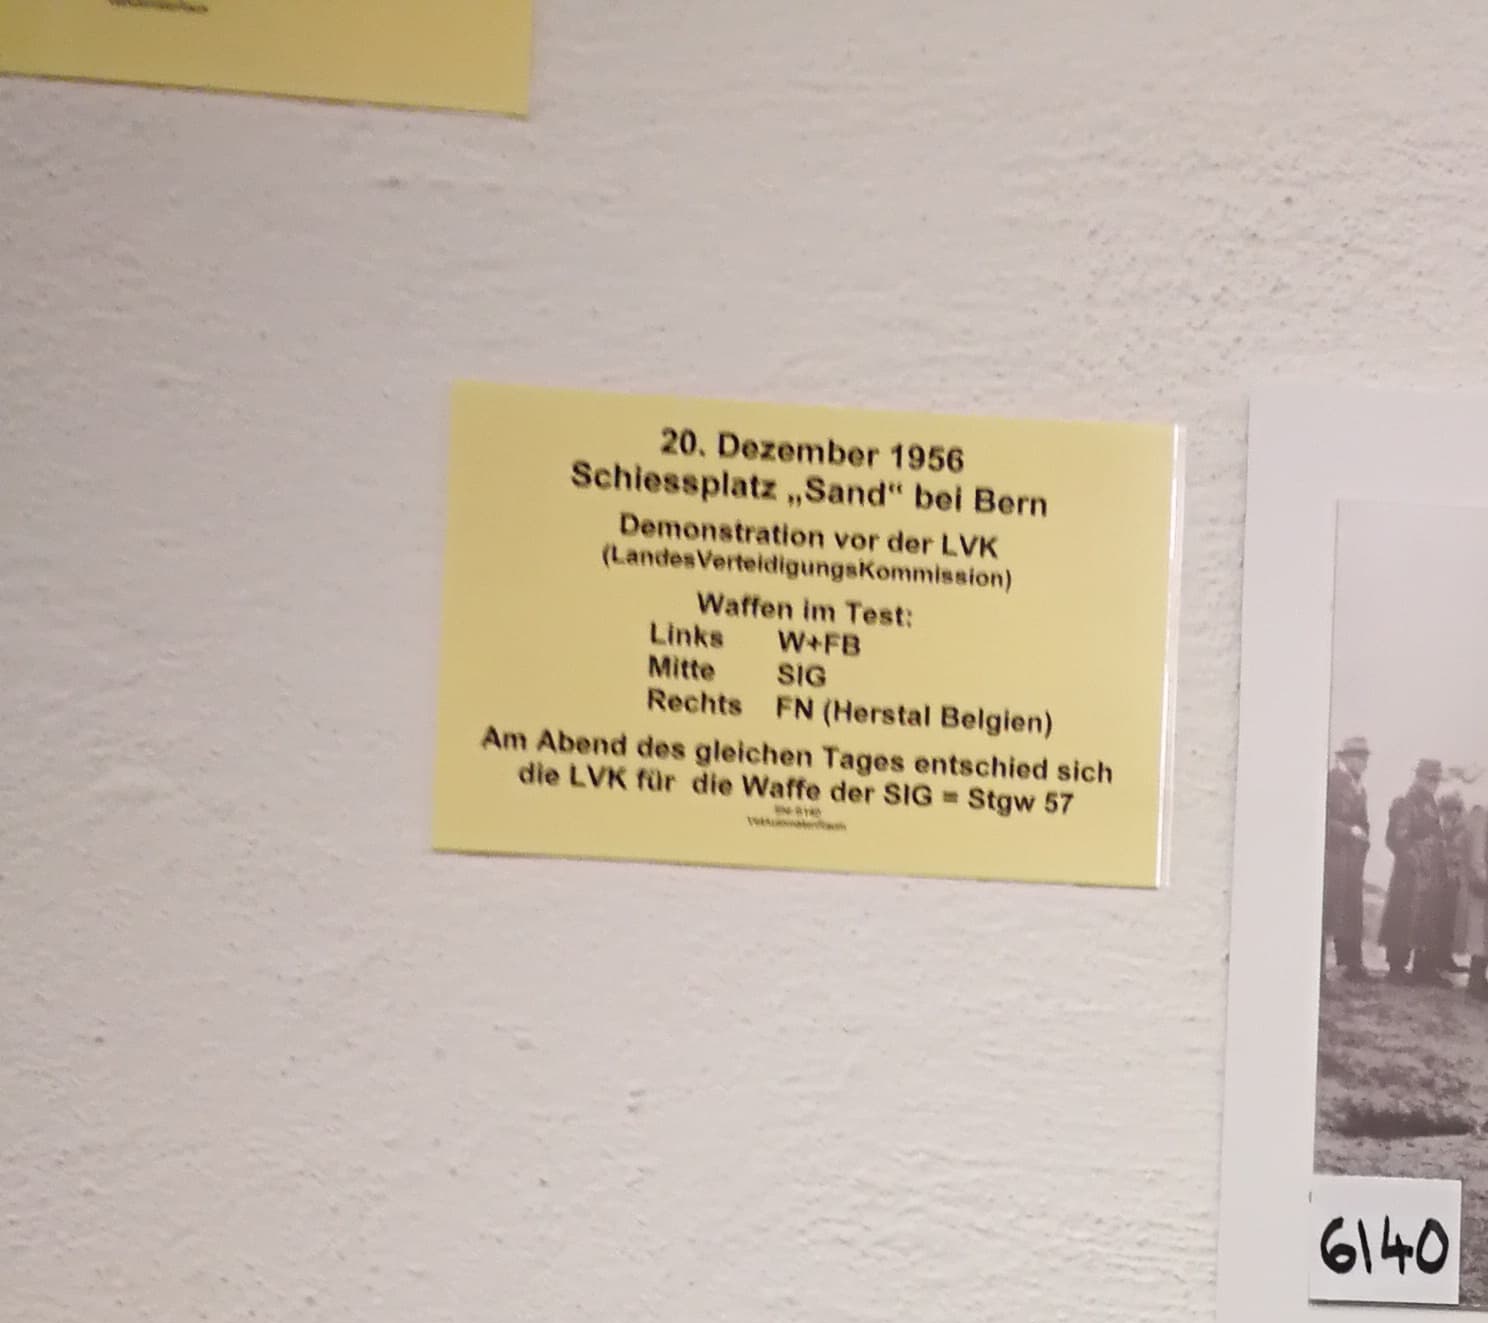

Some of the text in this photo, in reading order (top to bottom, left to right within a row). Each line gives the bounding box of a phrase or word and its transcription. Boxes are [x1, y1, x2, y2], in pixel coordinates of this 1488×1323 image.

[659, 426, 965, 475] 20. Dezember 1956
[570, 459, 778, 504] Schiessplatz
[914, 481, 963, 513] bei
[973, 485, 1048, 518] Bern
[619, 511, 999, 560] Demonstration vor der LVK
[601, 547, 1012, 594] (LandesVerteidigungsKommission)
[696, 590, 913, 629] Waffen im Test:
[649, 620, 862, 657] Links W+FB
[647, 653, 827, 689] Mitte SIG
[646, 686, 1053, 740] Rechts FN (Herstal Belgien)
[480, 724, 1113, 785] Am Abend des gleichen Tages entschied sich
[517, 760, 561, 787] die
[569, 762, 628, 791] LVK
[635, 767, 677, 793] für
[691, 770, 733, 797] die
[741, 773, 822, 802] Waffe
[829, 779, 876, 805] der
[883, 781, 933, 808] SIG
[967, 785, 1037, 818] Stgw
[1044, 790, 1075, 815] 57
[1320, 1214, 1450, 1275] 6140
